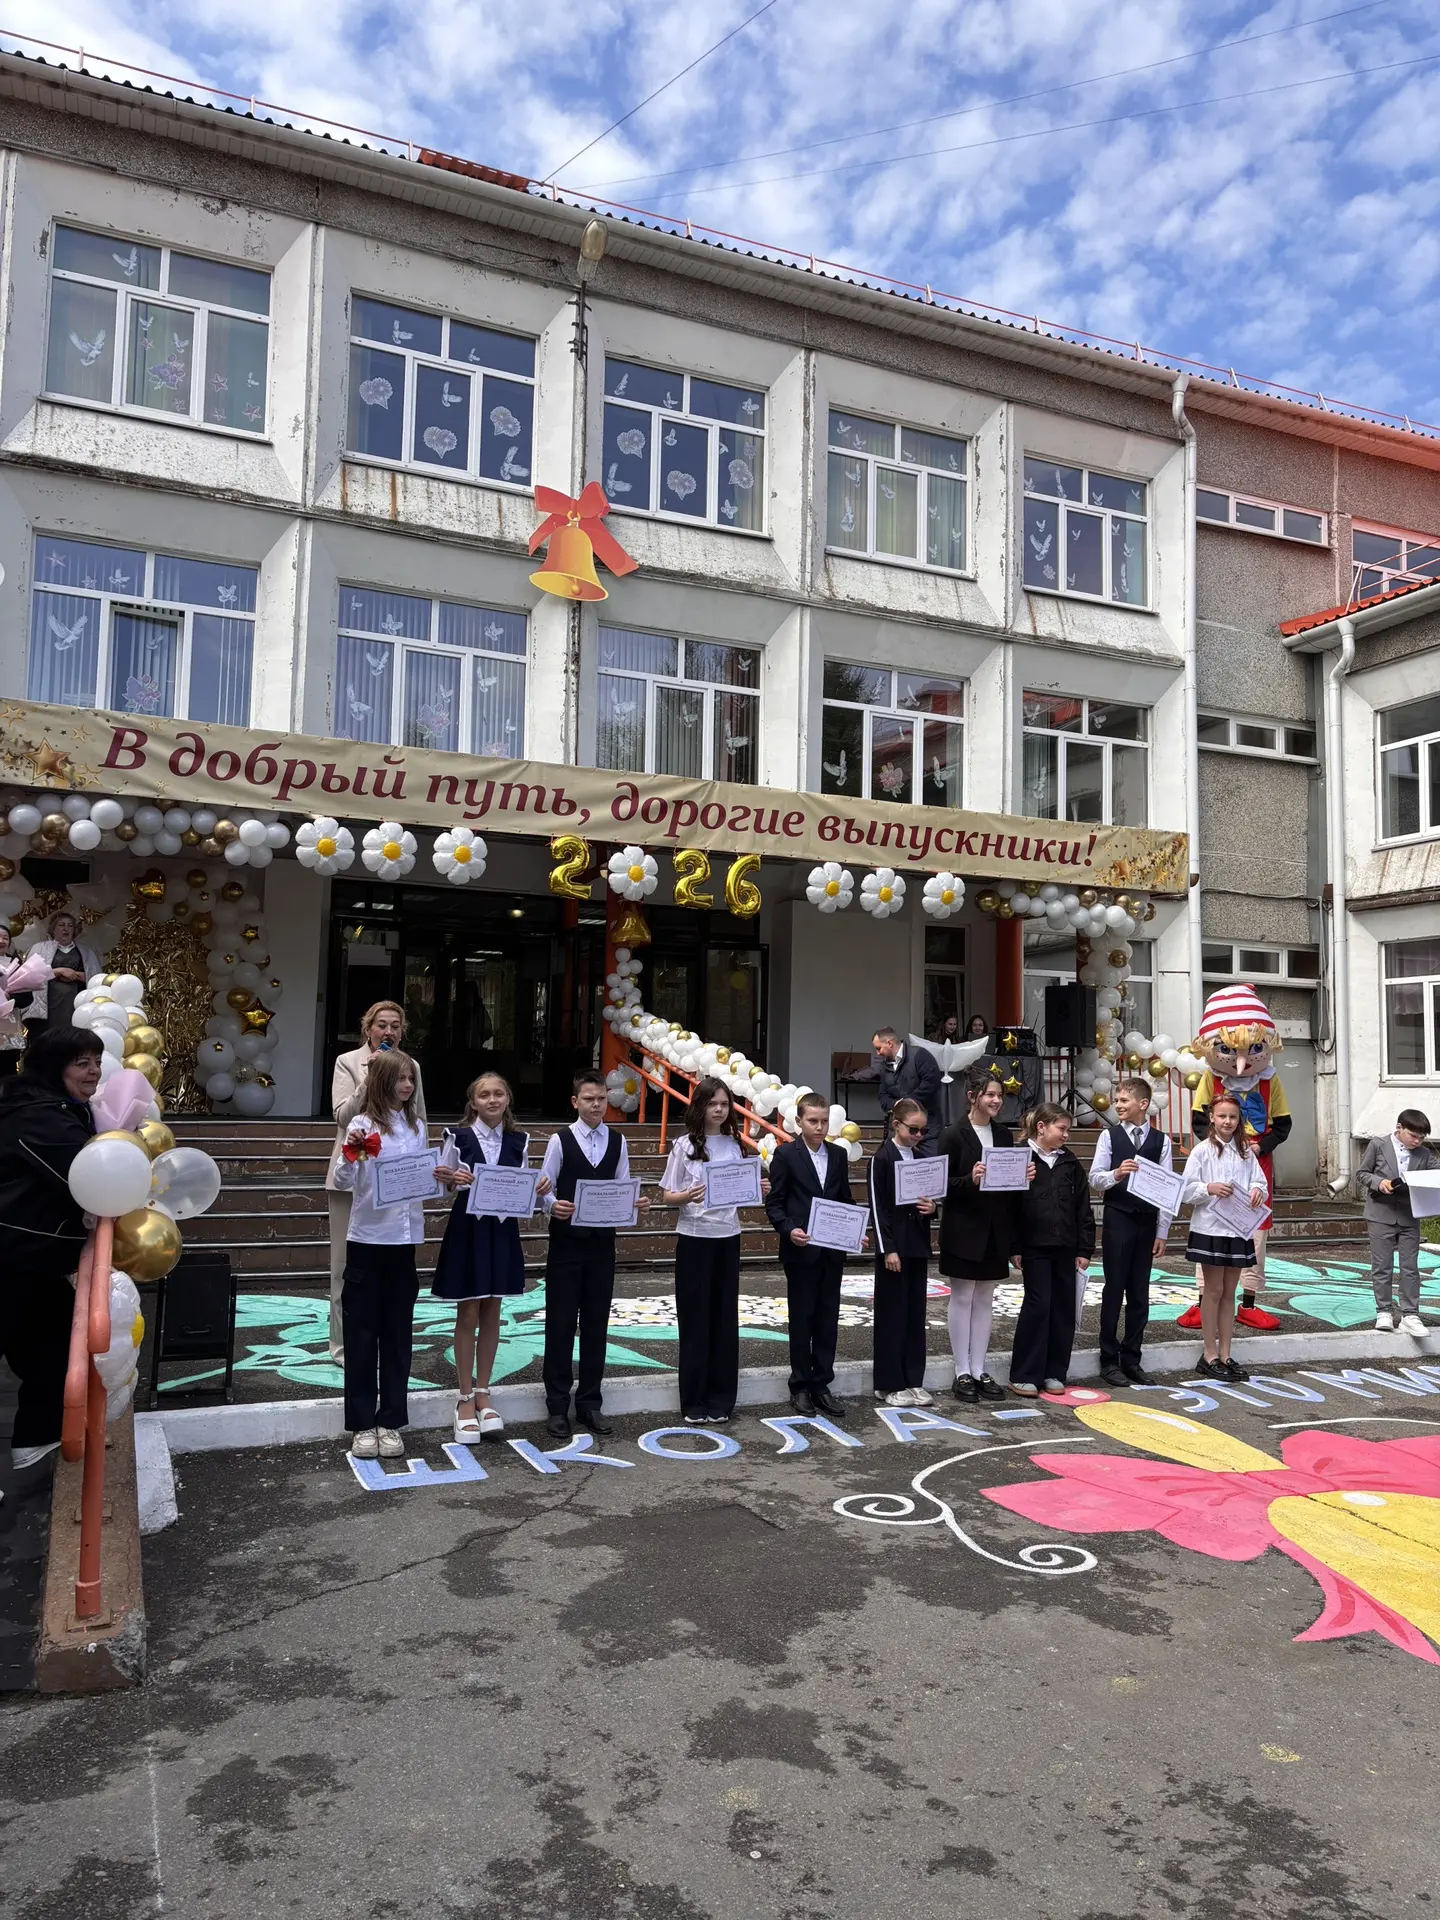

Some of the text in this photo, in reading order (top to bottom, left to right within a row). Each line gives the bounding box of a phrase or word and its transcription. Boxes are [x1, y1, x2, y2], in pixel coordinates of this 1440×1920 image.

[98, 725, 1098, 867] В добрый путь, дорогие выпускники!
